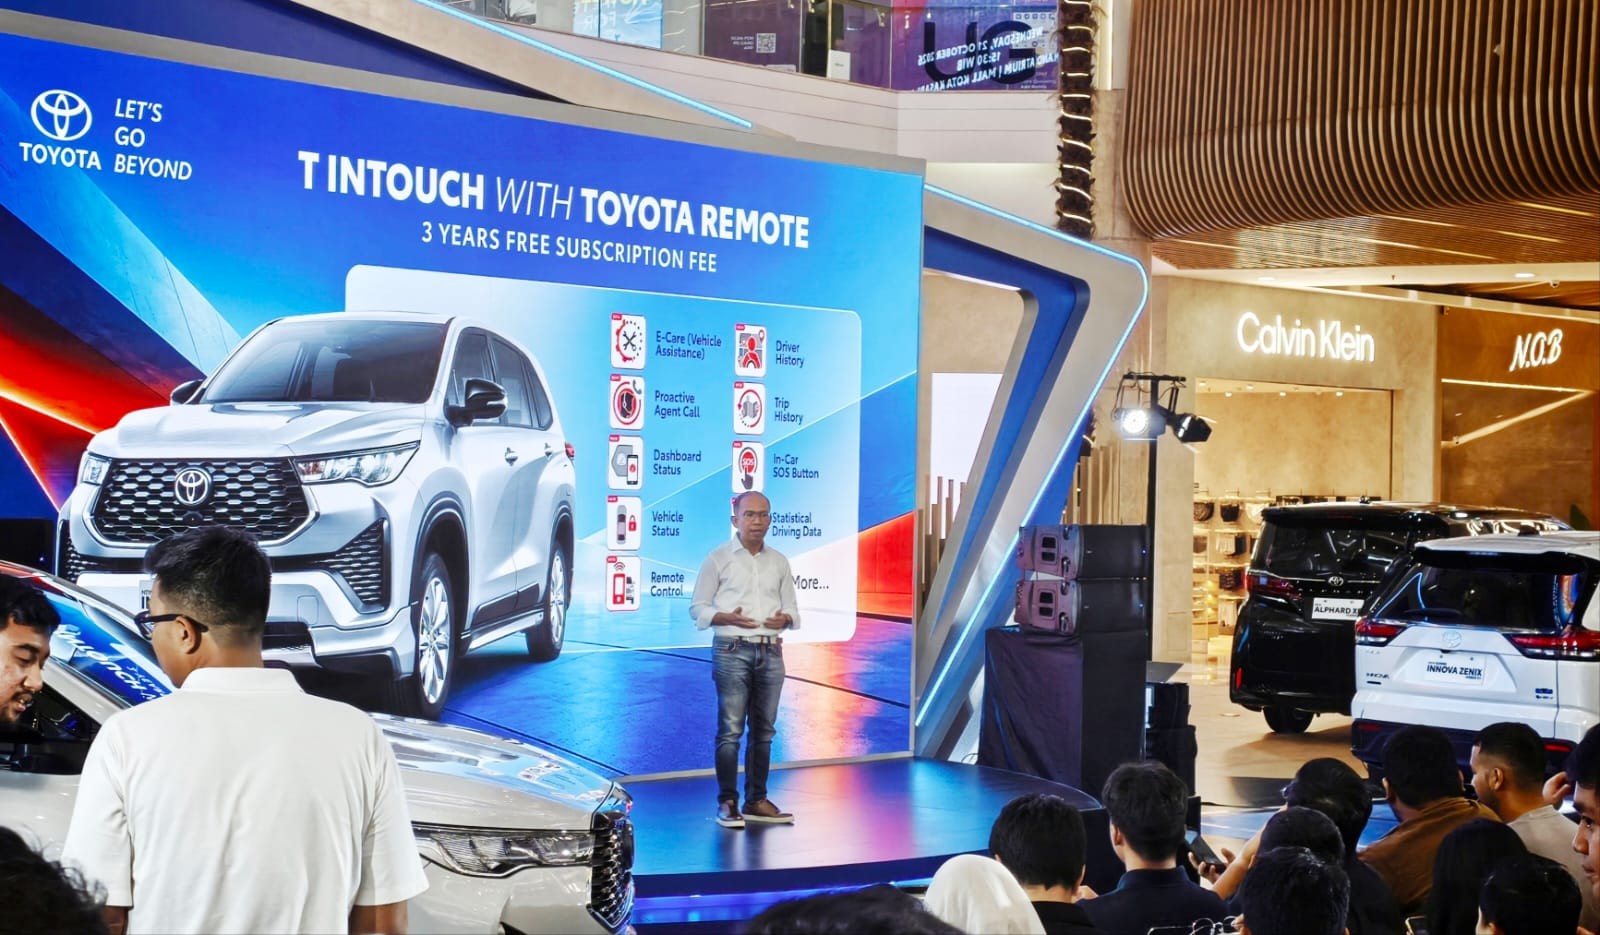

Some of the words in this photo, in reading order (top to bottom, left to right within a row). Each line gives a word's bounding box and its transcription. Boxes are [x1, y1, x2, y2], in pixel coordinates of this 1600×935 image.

[924, 20, 1037, 85] UG
[114, 97, 163, 122] LET'S
[114, 126, 146, 148] GO
[18, 141, 102, 171] TOYOTA
[114, 153, 192, 181] BEYOND
[298, 150, 320, 190] T
[327, 154, 485, 210] INTOUCH
[496, 176, 574, 221] WITH
[580, 187, 695, 236] TOYOTA
[701, 203, 809, 249] REMOTE
[421, 221, 433, 243] 3
[438, 223, 500, 250] YEARS
[506, 230, 550, 255] FREE
[555, 235, 684, 269] SUBSCRIPTION
[689, 251, 717, 273] FEE
[656, 330, 686, 345] E-Care
[687, 332, 722, 348] (Vehicle
[1236, 311, 1316, 358] Calvin
[1319, 319, 1375, 362] Klein
[655, 344, 705, 361] Assistance)
[775, 340, 800, 353] Driver
[1509, 328, 1564, 372] N.O.B
[775, 354, 805, 368] History
[655, 390, 695, 404] Proactive
[774, 396, 790, 410] Trip
[654, 404, 681, 419] Agent
[682, 405, 701, 419] Call
[774, 410, 804, 425] History
[653, 448, 702, 462] Dashboard
[773, 453, 799, 466] In-Car
[652, 463, 682, 476] Status
[772, 467, 790, 479] SOS
[792, 467, 819, 480] Button
[652, 510, 684, 523] Vehicle
[772, 512, 812, 524] Statistical
[651, 524, 680, 537] Status
[772, 525, 801, 540] Driving
[802, 526, 822, 537] Data
[651, 571, 685, 583] Remote
[650, 585, 684, 597] Control
[1314, 606, 1351, 615] ALPHARD
[1426, 664, 1458, 675] INNOVA
[1459, 666, 1483, 677] ZENIX
